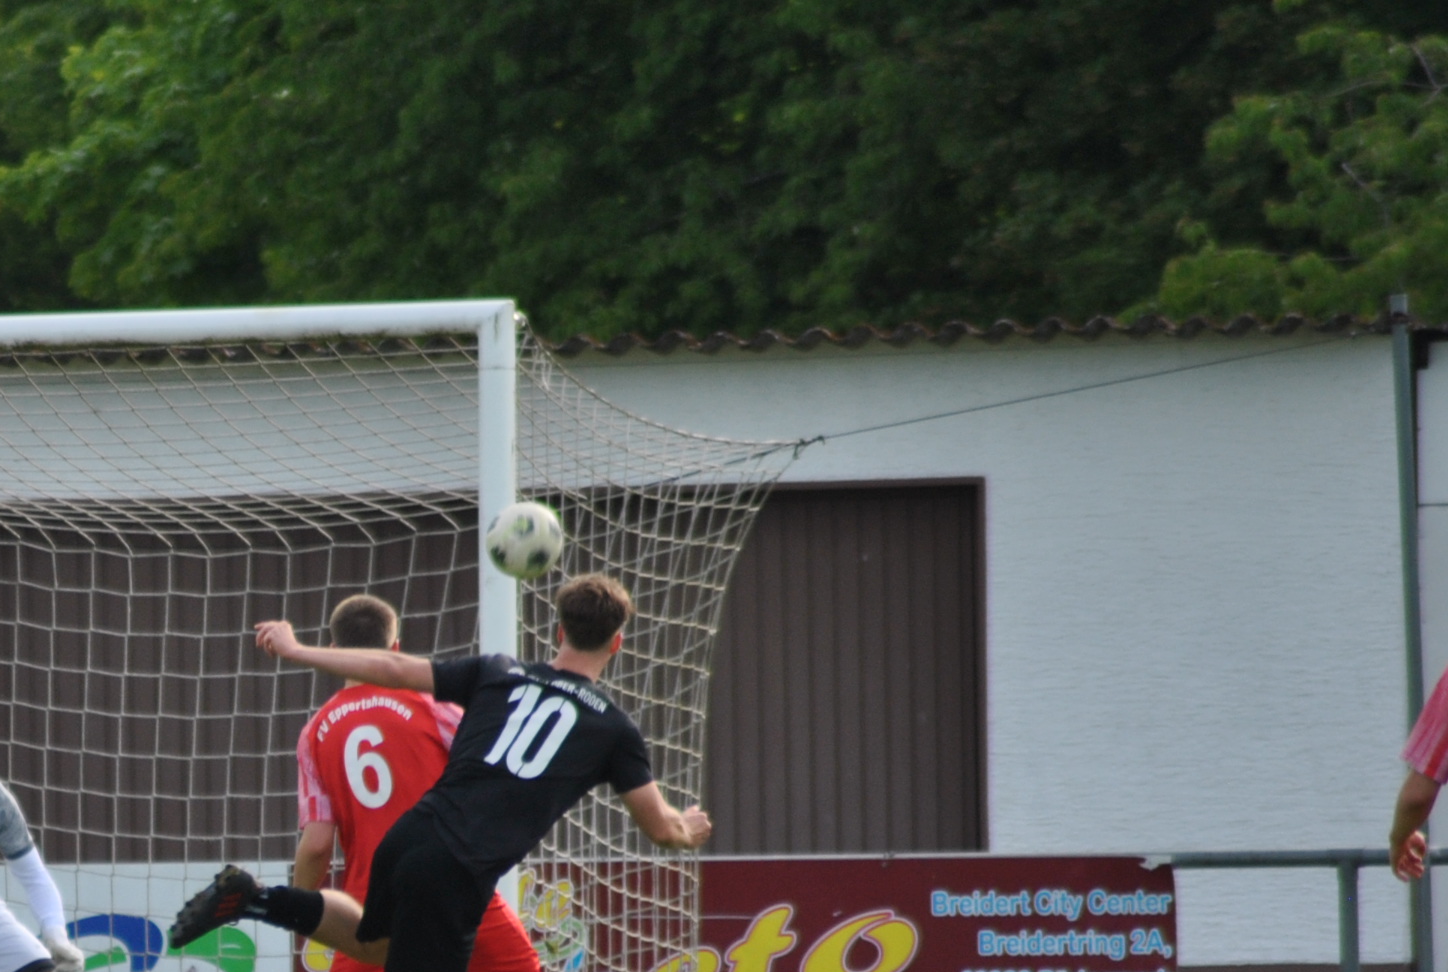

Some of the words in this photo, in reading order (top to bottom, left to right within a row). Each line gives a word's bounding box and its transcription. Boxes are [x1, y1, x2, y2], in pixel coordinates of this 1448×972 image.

[483, 684, 578, 779] 10
[343, 725, 393, 809] 6
[931, 890, 1031, 917] Breidert
[1034, 889, 1082, 921] City
[1087, 889, 1172, 916] Center
[978, 929, 1125, 960] Breidertring
[1130, 928, 1173, 959] 2A,
